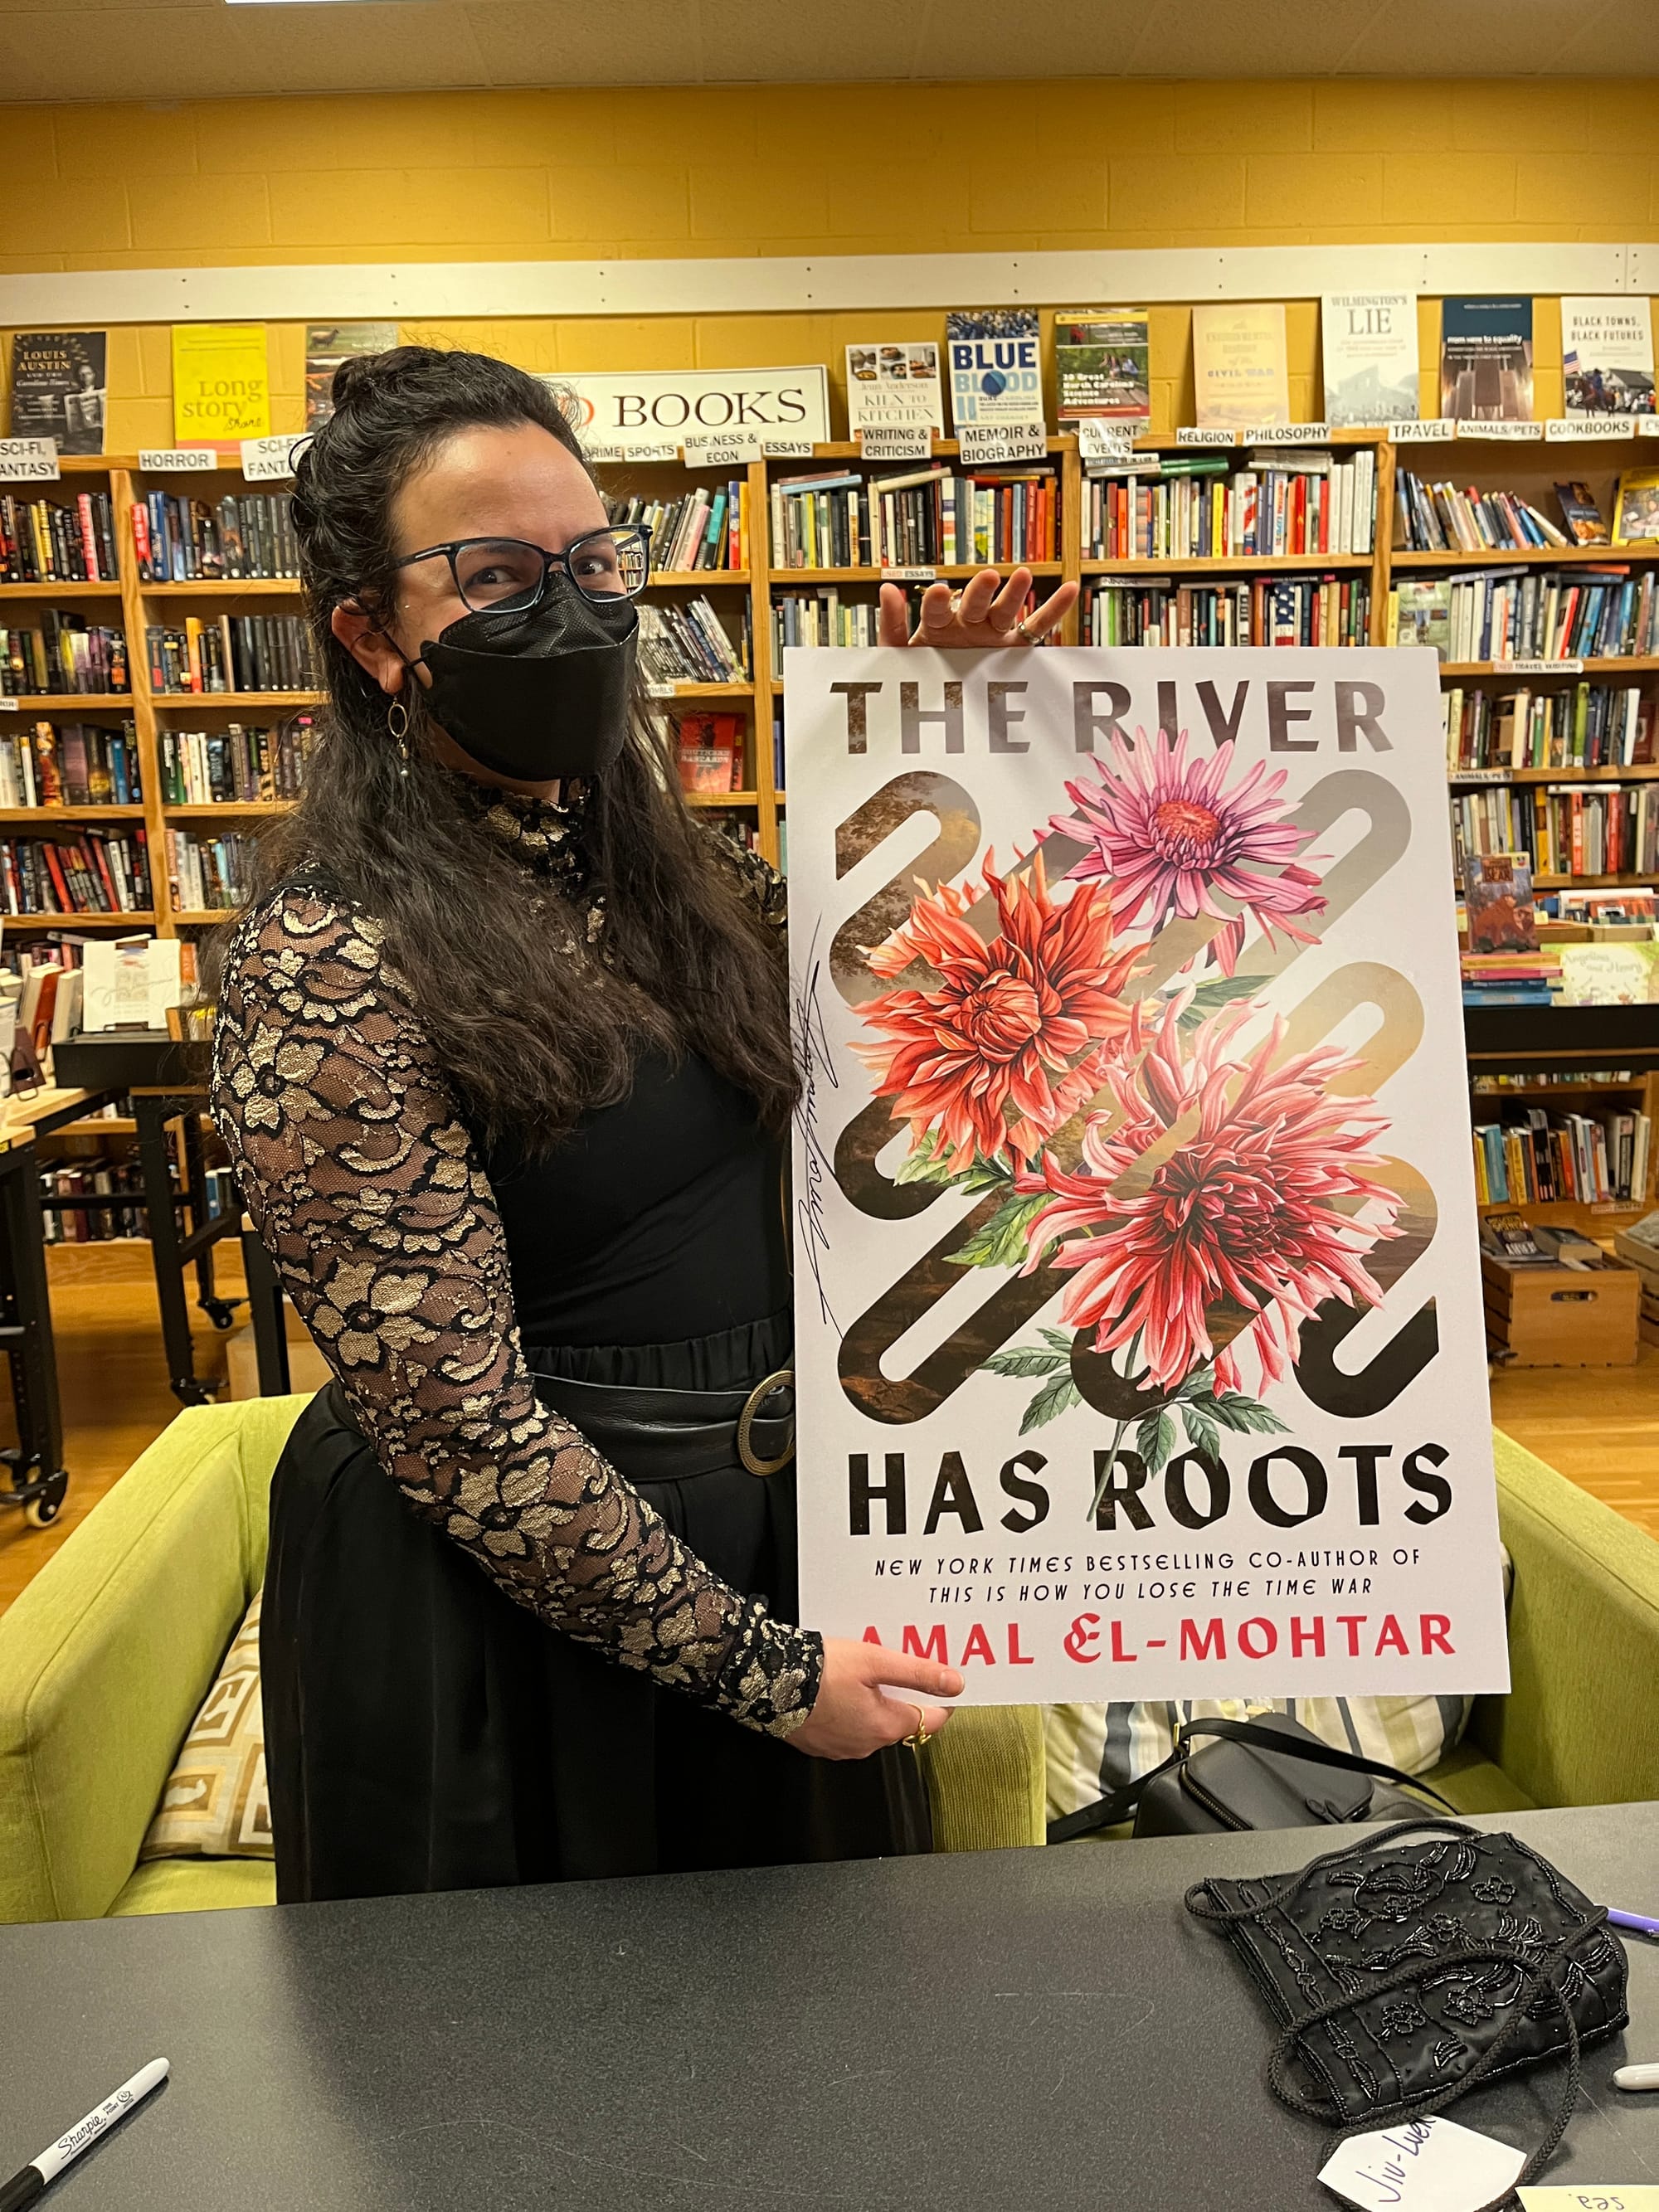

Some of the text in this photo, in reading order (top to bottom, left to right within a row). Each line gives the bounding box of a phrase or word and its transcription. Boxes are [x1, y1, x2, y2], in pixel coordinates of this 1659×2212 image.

[1331, 295, 1408, 307] WILMINGTON'S
[1347, 308, 1392, 335] LIE
[1573, 316, 1601, 326] BLACK
[1571, 330, 1644, 341] BLACK FUTURES
[22, 350, 68, 361] LOUIS
[953, 342, 1036, 370] BLUE
[17, 360, 72, 372] AUSTIN
[954, 372, 1038, 393] BLOD
[198, 380, 264, 402] Long
[182, 400, 248, 420] story
[613, 389, 806, 428] BOOKS
[858, 409, 934, 422] KITCHEN
[863, 429, 927, 440] WRITING &
[966, 425, 1039, 443] MEMOIR &
[1246, 426, 1329, 440] PHILOSOPHY
[1393, 424, 1449, 439] TRAVEL
[1459, 424, 1541, 435] ANIMALS/PETS
[1550, 421, 1630, 435] COOKBOOKS
[685, 433, 757, 448] BUSNESS &
[1178, 430, 1233, 443] RELIGION
[627, 445, 675, 457] SPORTS
[765, 441, 810, 453] ESSAYS
[865, 445, 925, 457] CRITICISM
[962, 444, 1044, 462] BIOGRAPHY
[1087, 441, 1131, 454] EVETS
[141, 454, 210, 468] HORROR
[706, 450, 739, 463] ECON
[0, 461, 57, 476] ANTASY
[248, 460, 290, 476] FANT
[904, 570, 934, 578] ESSAYS
[830, 680, 1394, 755] THE RIVER
[848, 1442, 1452, 1535] HAS ROOTS
[875, 1548, 1420, 1577] NEW YORK TIMES BESTSELLING CO-AUTHOR OF
[929, 1578, 1372, 1603] THIS IS HOW YOU LOSE THE TIME WAR
[1063, 1612, 1456, 1664] EL-MOHTAR
[57, 2115, 107, 2160] Sharpie
